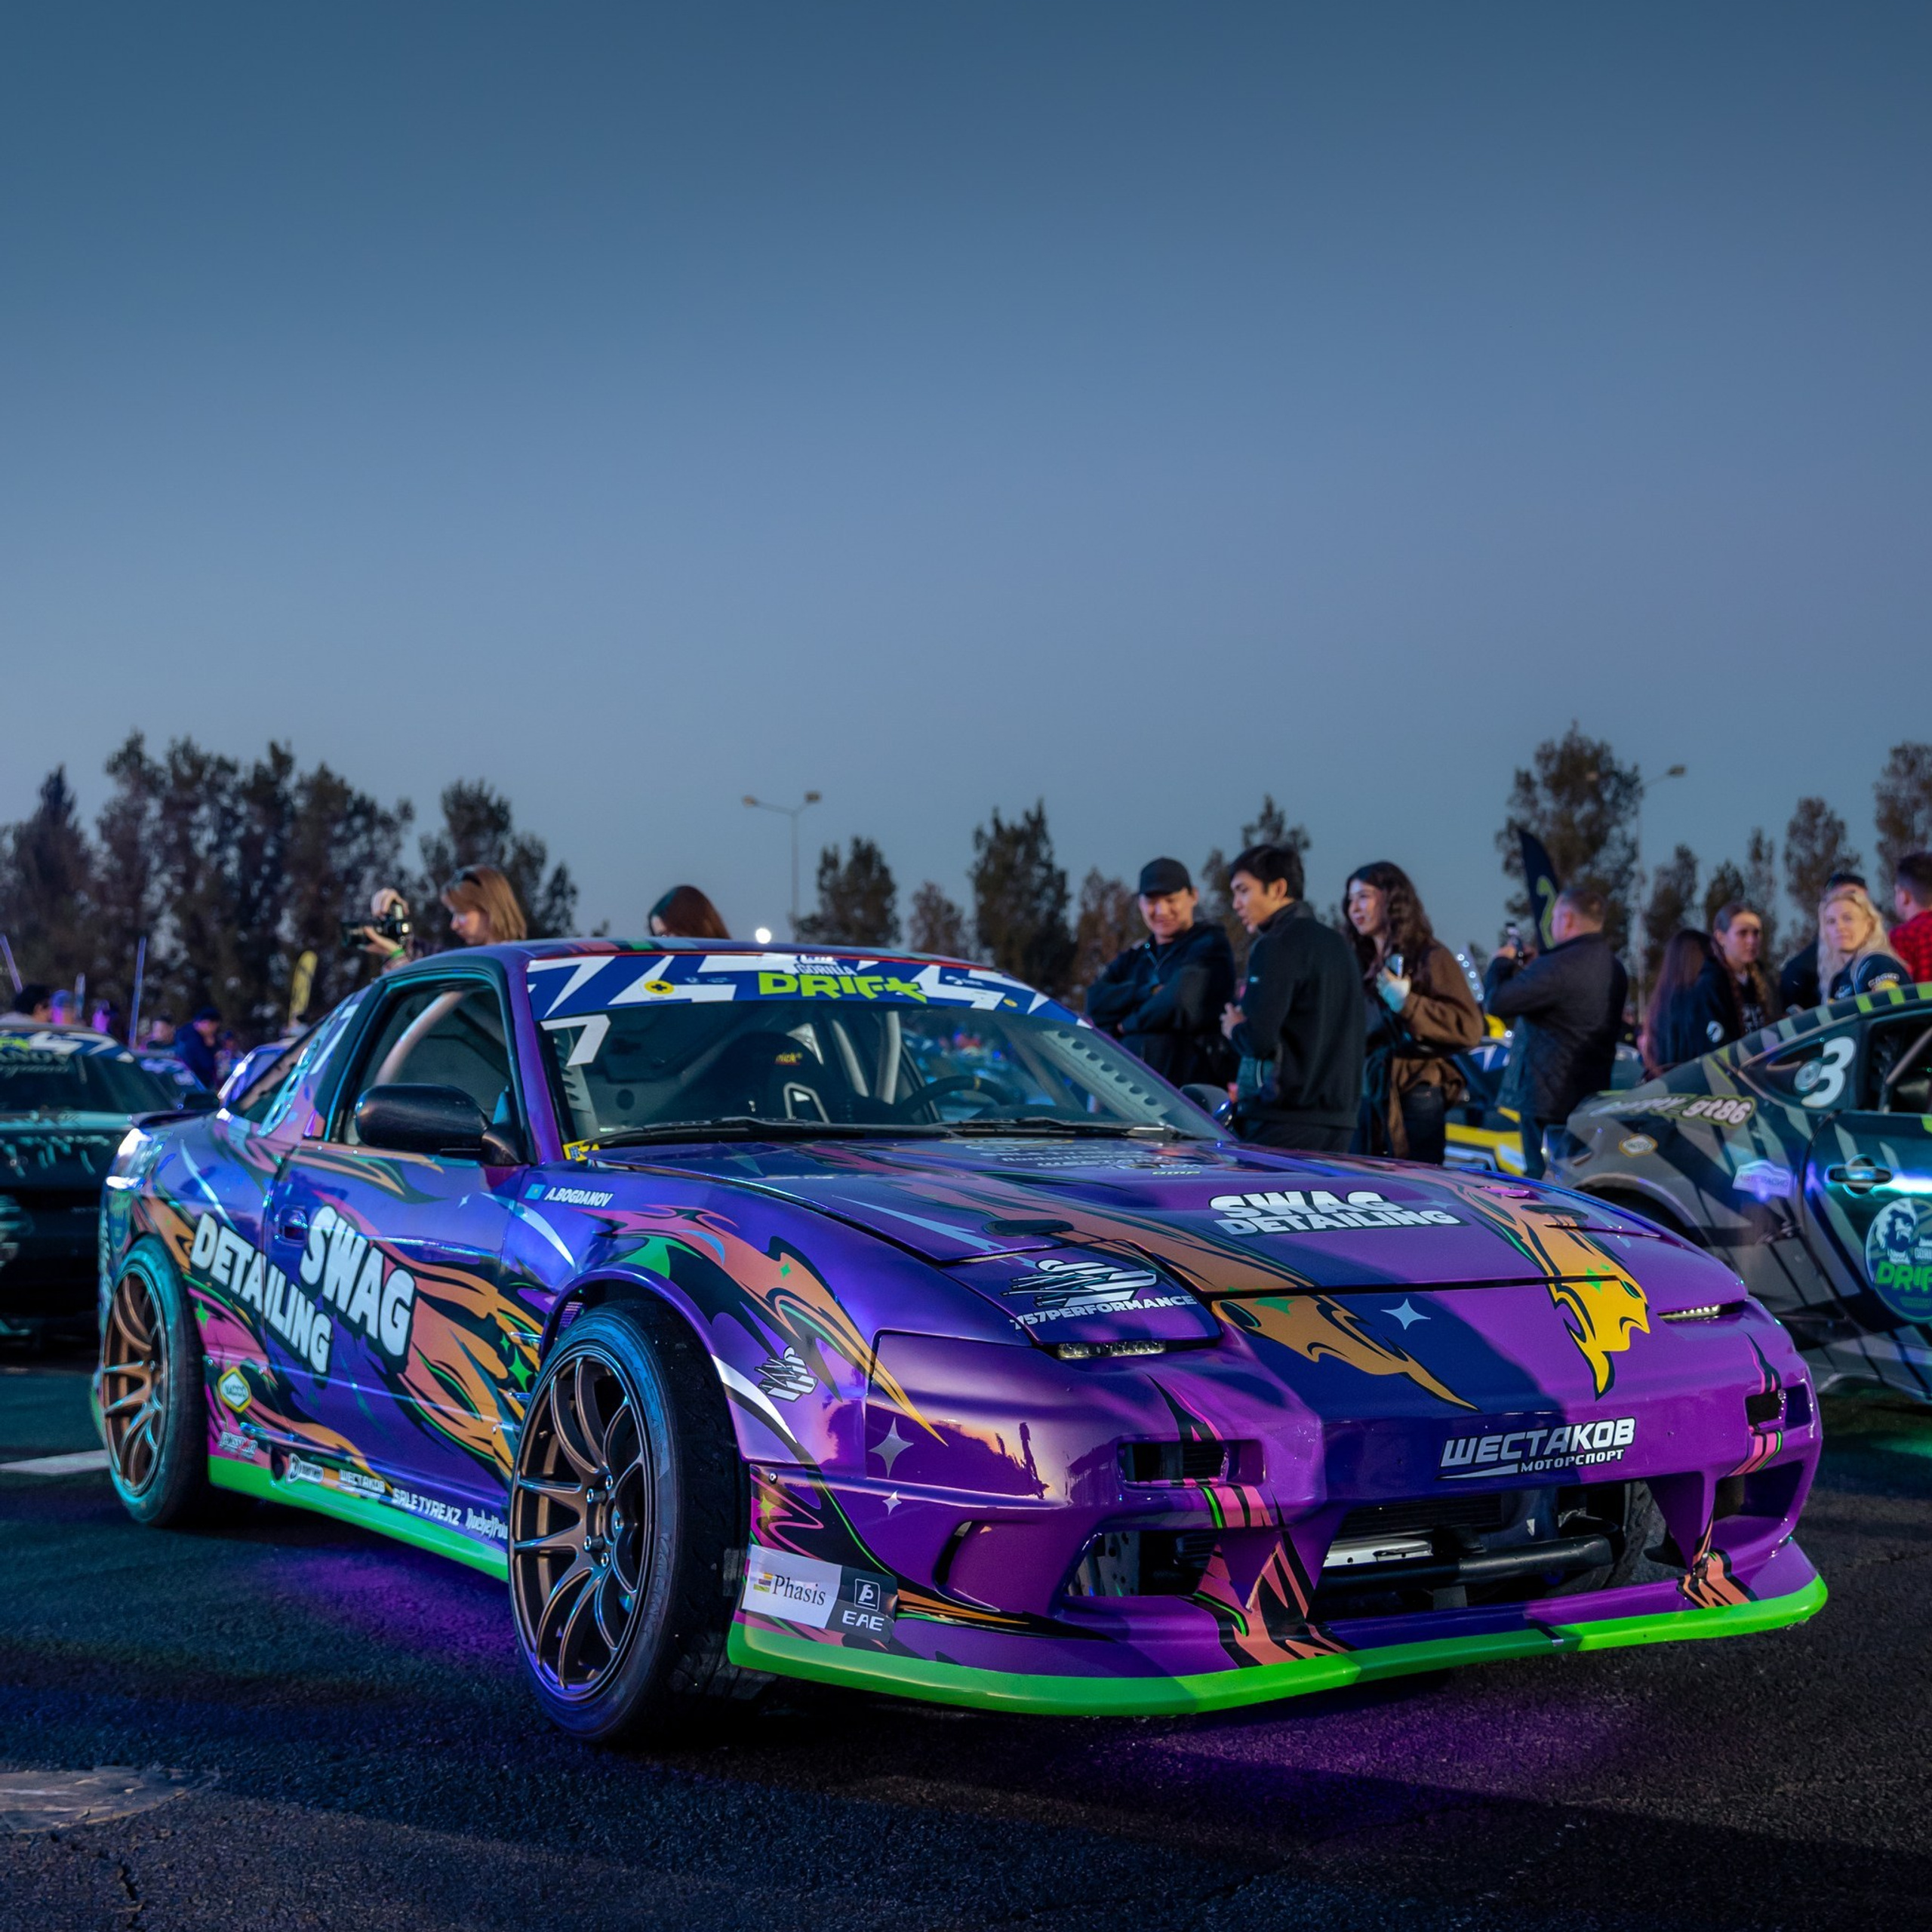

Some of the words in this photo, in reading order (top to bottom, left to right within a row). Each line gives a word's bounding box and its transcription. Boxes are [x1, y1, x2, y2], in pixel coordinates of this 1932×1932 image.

[795, 964, 858, 977] GORILLA
[758, 972, 928, 1004] DRIFT
[540, 1014, 611, 1067] 7
[1801, 1035, 1857, 1109] 3
[544, 1187, 614, 1207] A.BOGDANOV
[1209, 1190, 1404, 1219] SWAG
[1214, 1209, 1461, 1235] DETAILING
[190, 1212, 332, 1374] DETAILING
[300, 1205, 416, 1355] SWAG
[1441, 1418, 1636, 1467] ШЕСТАКОВ
[1521, 1449, 1625, 1473] МОТОРСПОРТ
[773, 1574, 826, 1607] Phasis
[842, 1611, 884, 1632] EAE
